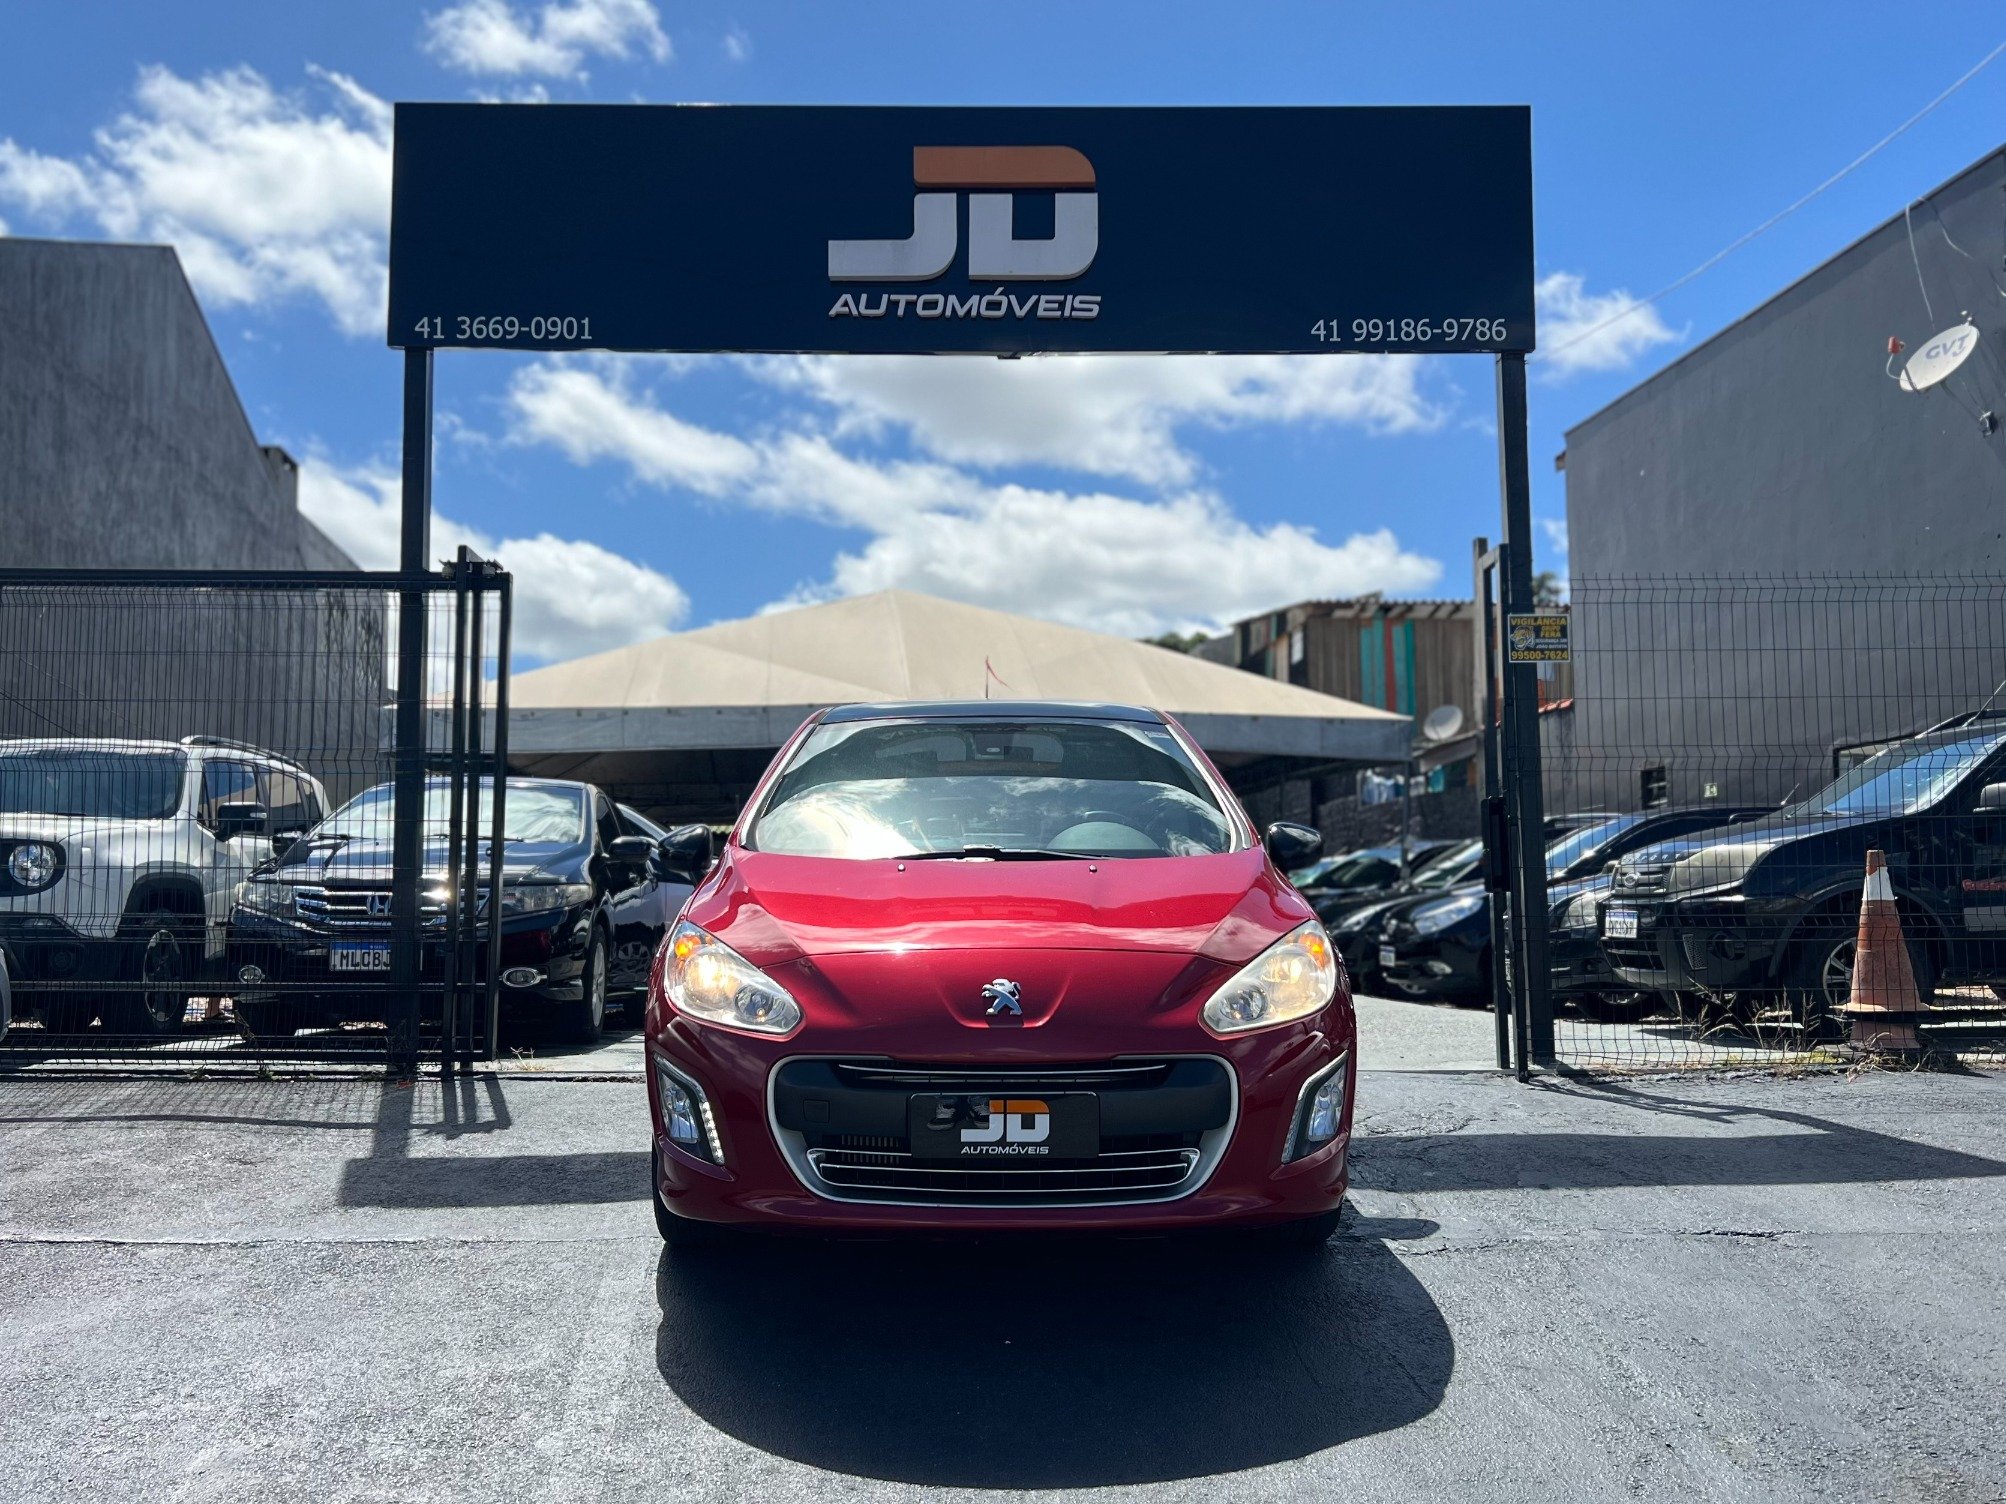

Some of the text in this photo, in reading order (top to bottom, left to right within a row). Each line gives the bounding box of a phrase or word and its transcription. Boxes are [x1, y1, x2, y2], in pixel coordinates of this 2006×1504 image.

[827, 145, 1099, 282] JD
[828, 287, 1102, 319] AUTOMÓVEIS
[414, 316, 593, 340] 41 3669-0901
[1310, 318, 1507, 342] 41 99186-9786
[1511, 651, 1568, 660] 99500-7624
[960, 1099, 1050, 1143] JD
[960, 1143, 1050, 1155] AUTOMÓVEIS
